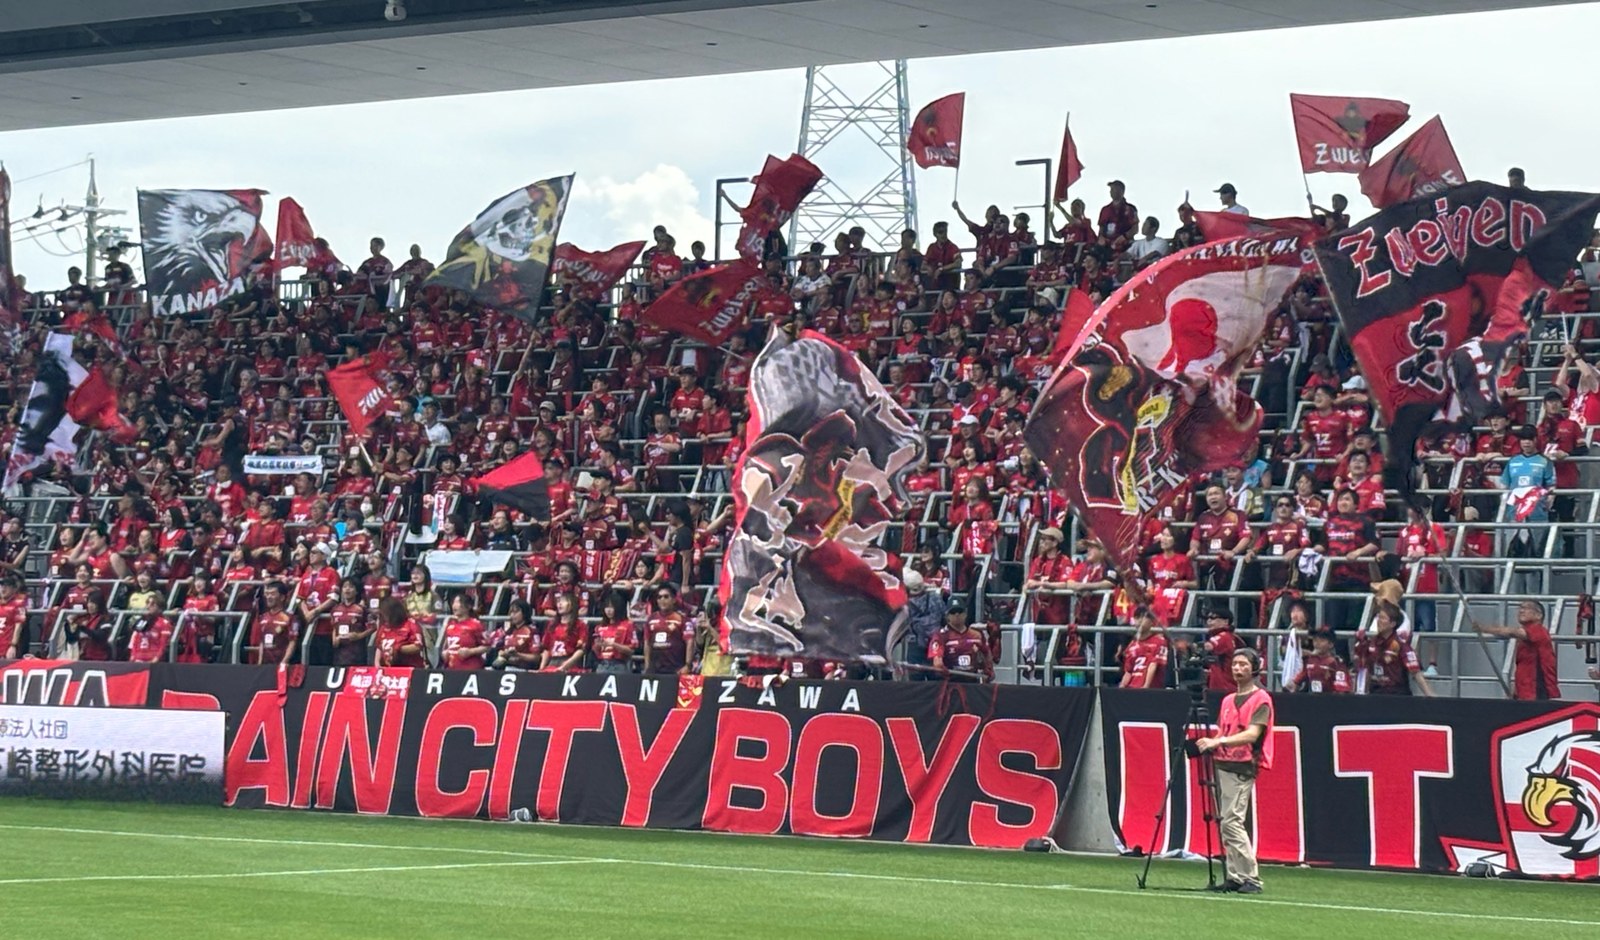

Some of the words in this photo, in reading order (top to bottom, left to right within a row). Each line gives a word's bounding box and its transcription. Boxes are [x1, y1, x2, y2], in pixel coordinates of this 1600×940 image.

[326, 667, 516, 695] URAS
[0, 746, 207, 784] 崎整形外科医院
[162, 688, 408, 814] AIN
[415, 697, 698, 828] CITY
[701, 707, 1062, 850] BOYS
